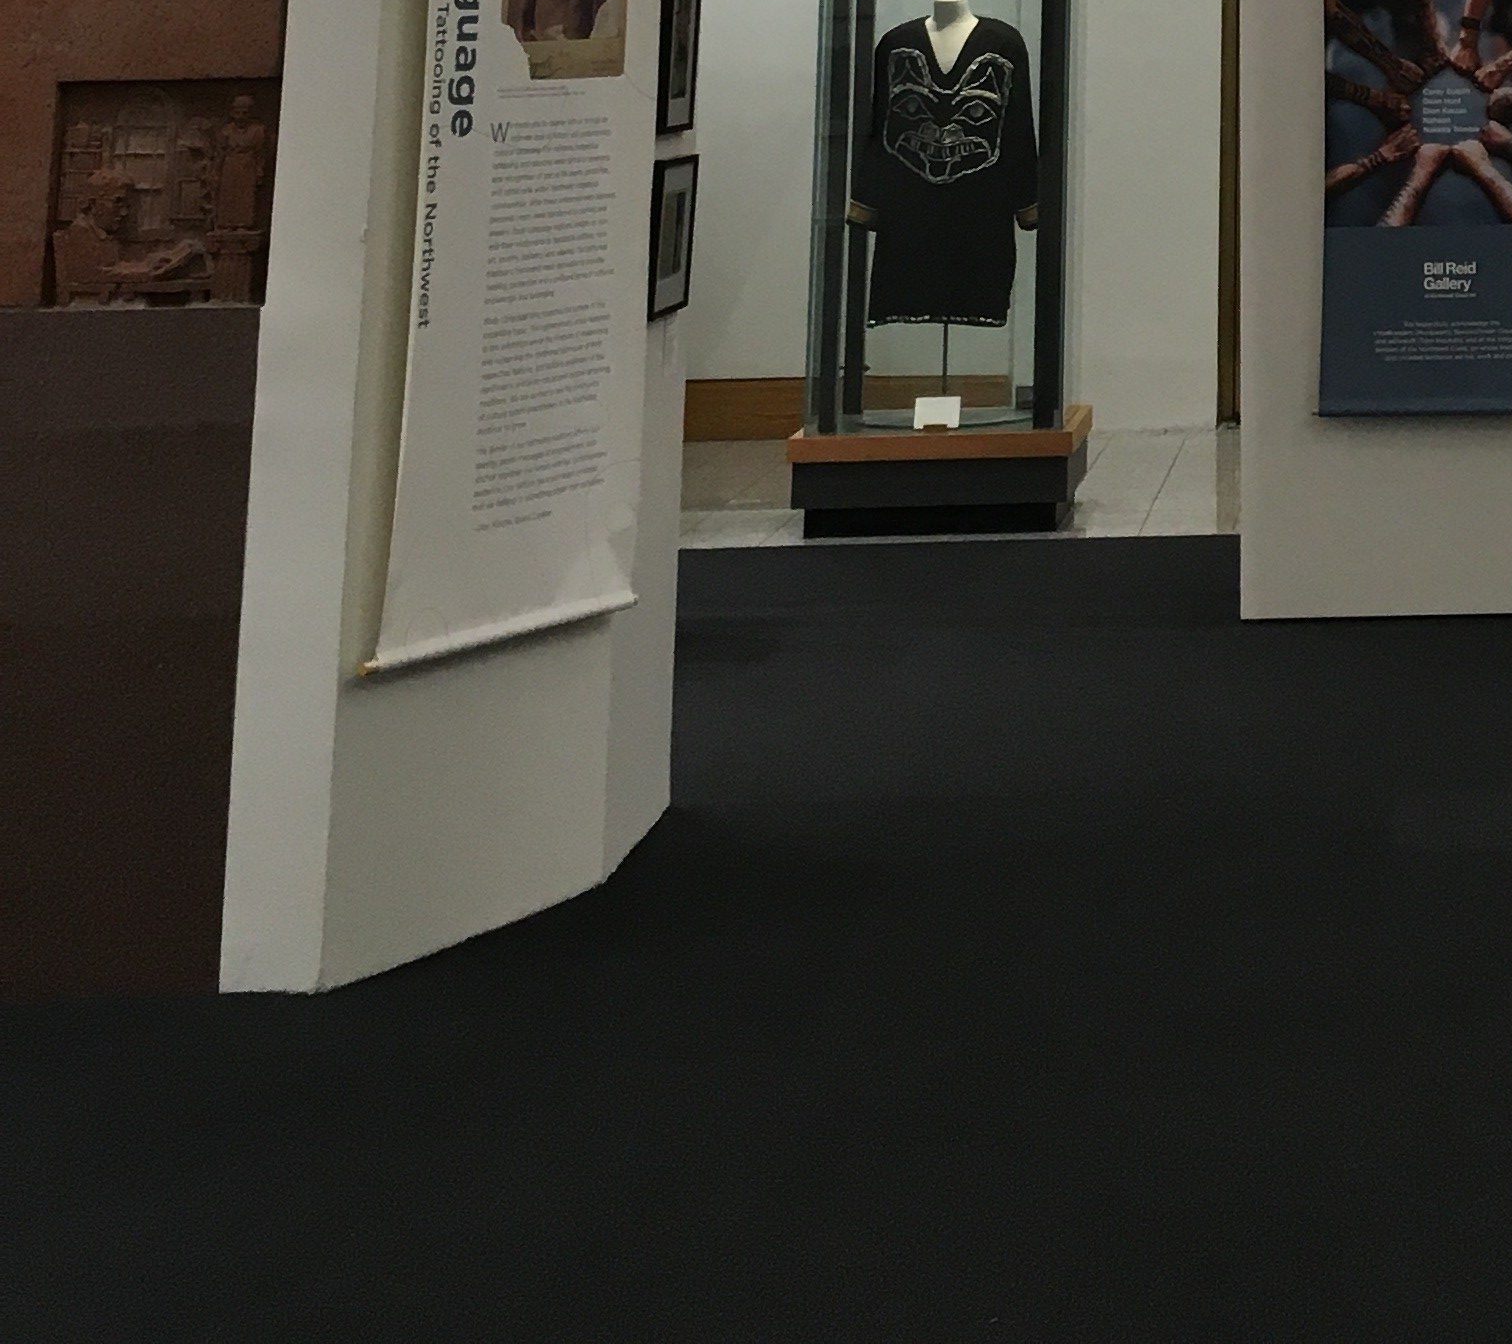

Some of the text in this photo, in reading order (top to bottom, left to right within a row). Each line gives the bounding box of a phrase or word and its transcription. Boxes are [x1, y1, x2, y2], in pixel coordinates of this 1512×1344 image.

[429, 2, 450, 115] Tattooing
[428, 123, 442, 148] of
[426, 155, 440, 194] the
[418, 202, 438, 329] Northwest
[1424, 261, 1477, 275] Bill Reid
[1424, 277, 1472, 292] Gallery
